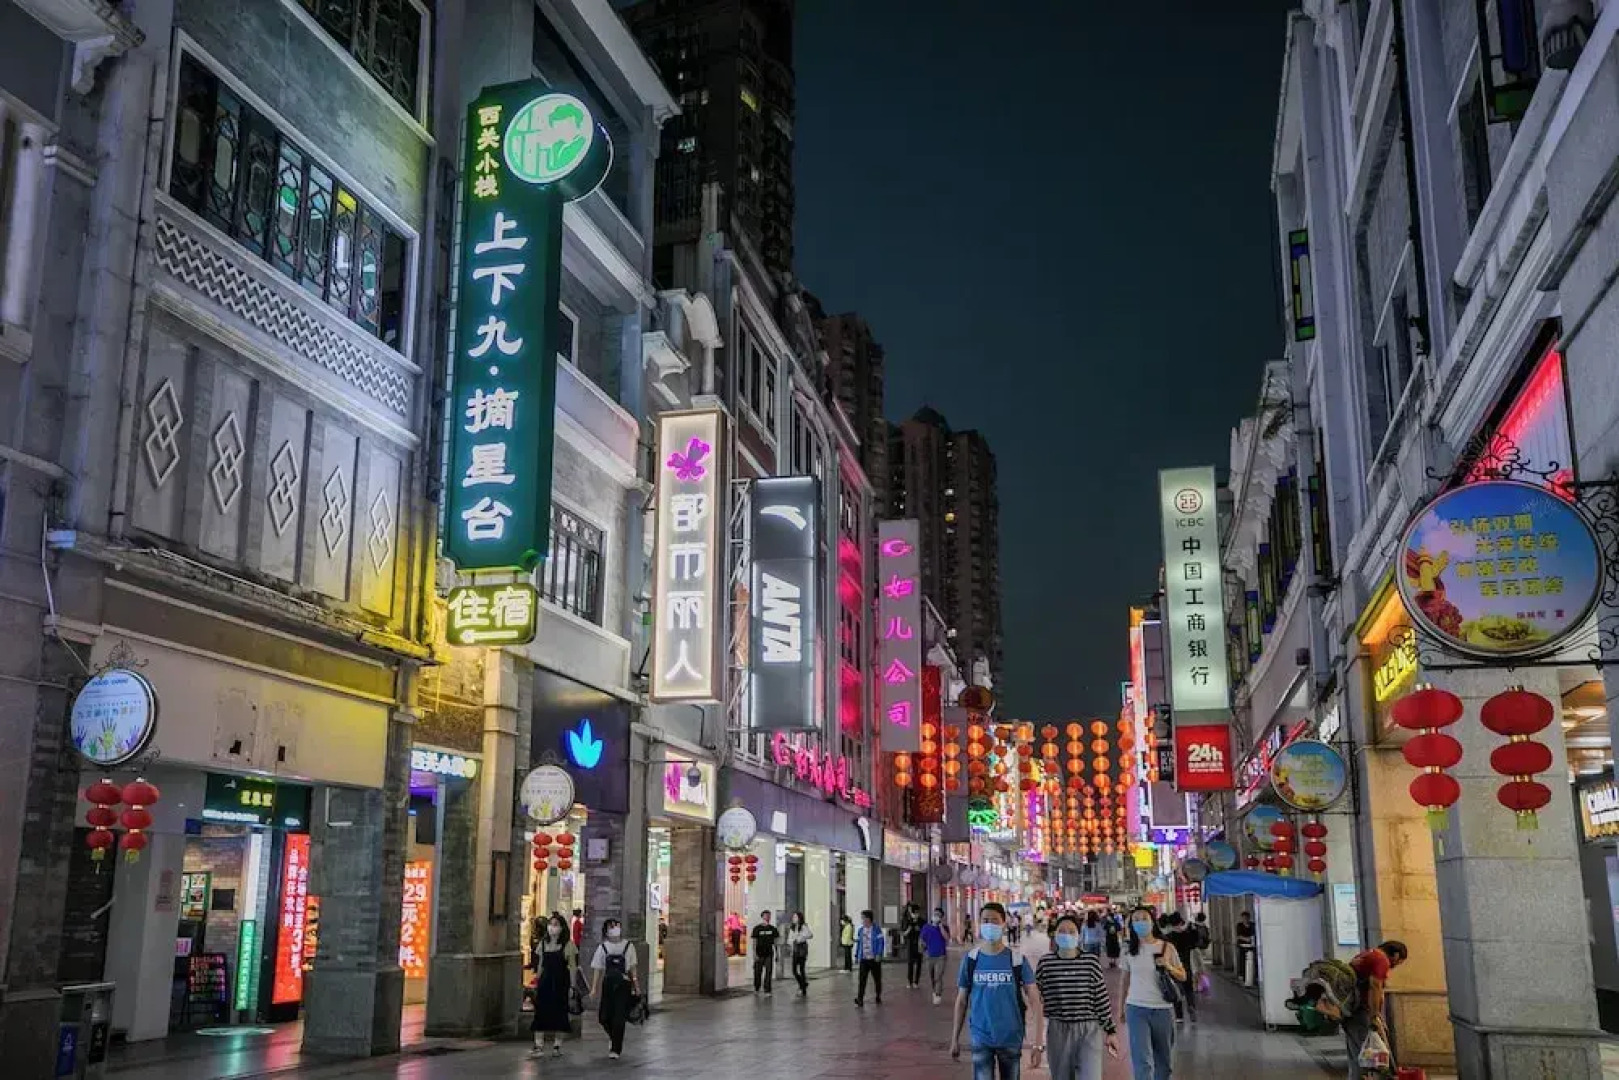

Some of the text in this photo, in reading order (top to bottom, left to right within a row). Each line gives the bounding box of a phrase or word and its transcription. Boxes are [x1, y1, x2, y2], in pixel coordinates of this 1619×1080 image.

[474, 105, 503, 198] 西关小栈
[1175, 517, 1204, 527] ICBC
[448, 586, 532, 627] 住宿
[664, 493, 708, 681] 都市丽人
[761, 572, 801, 663] ANTA
[1182, 536, 1209, 685] 中国工商银行
[1188, 743, 1224, 762] 24h
[973, 972, 1012, 982] ENERGY
